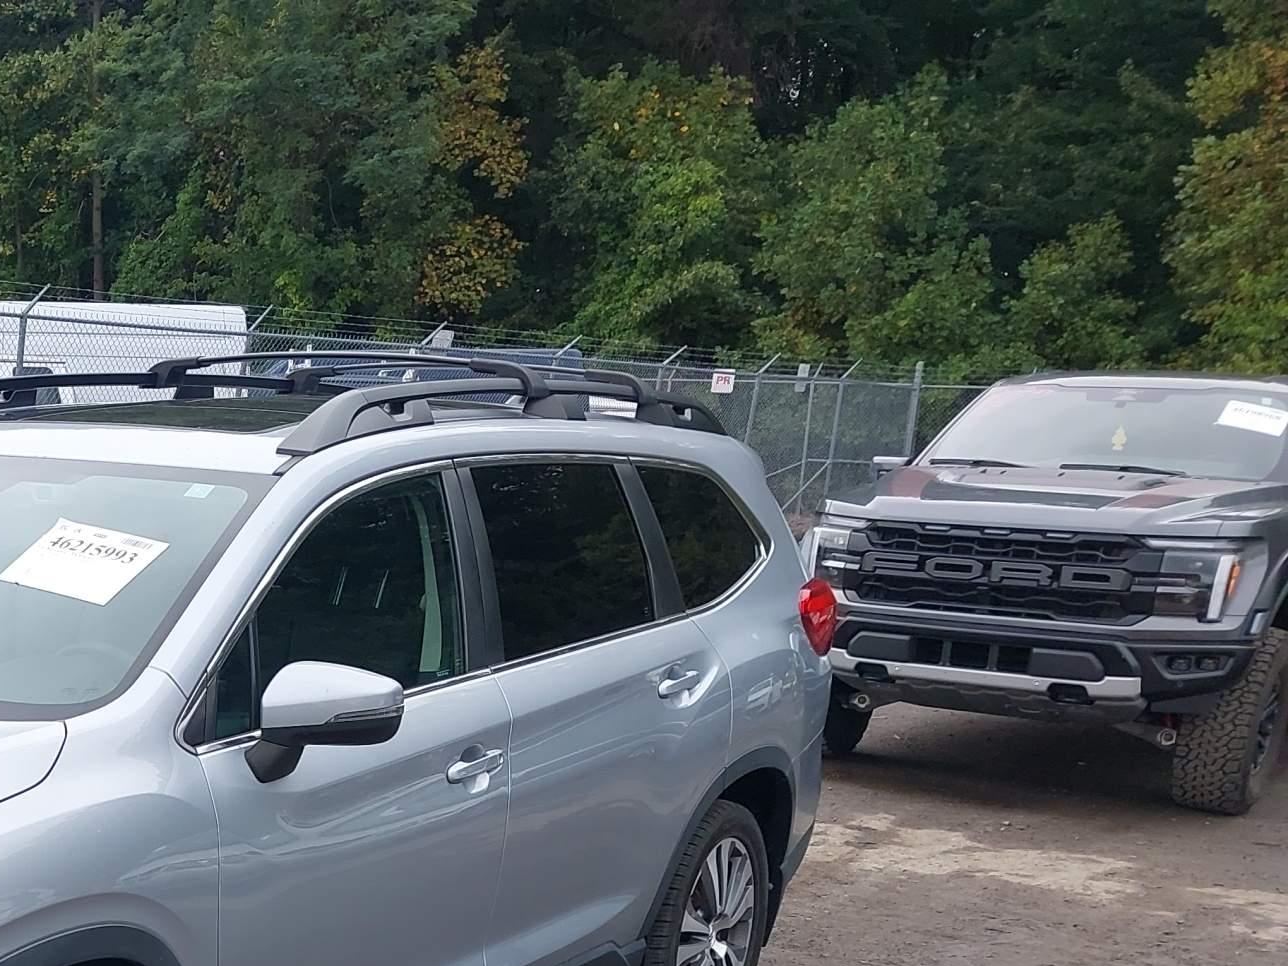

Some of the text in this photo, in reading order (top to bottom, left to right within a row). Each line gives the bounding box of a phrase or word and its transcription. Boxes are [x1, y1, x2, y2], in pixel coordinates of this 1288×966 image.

[716, 375, 731, 385] PR
[49, 536, 139, 564] 46215993
[861, 550, 1133, 591] FORD
